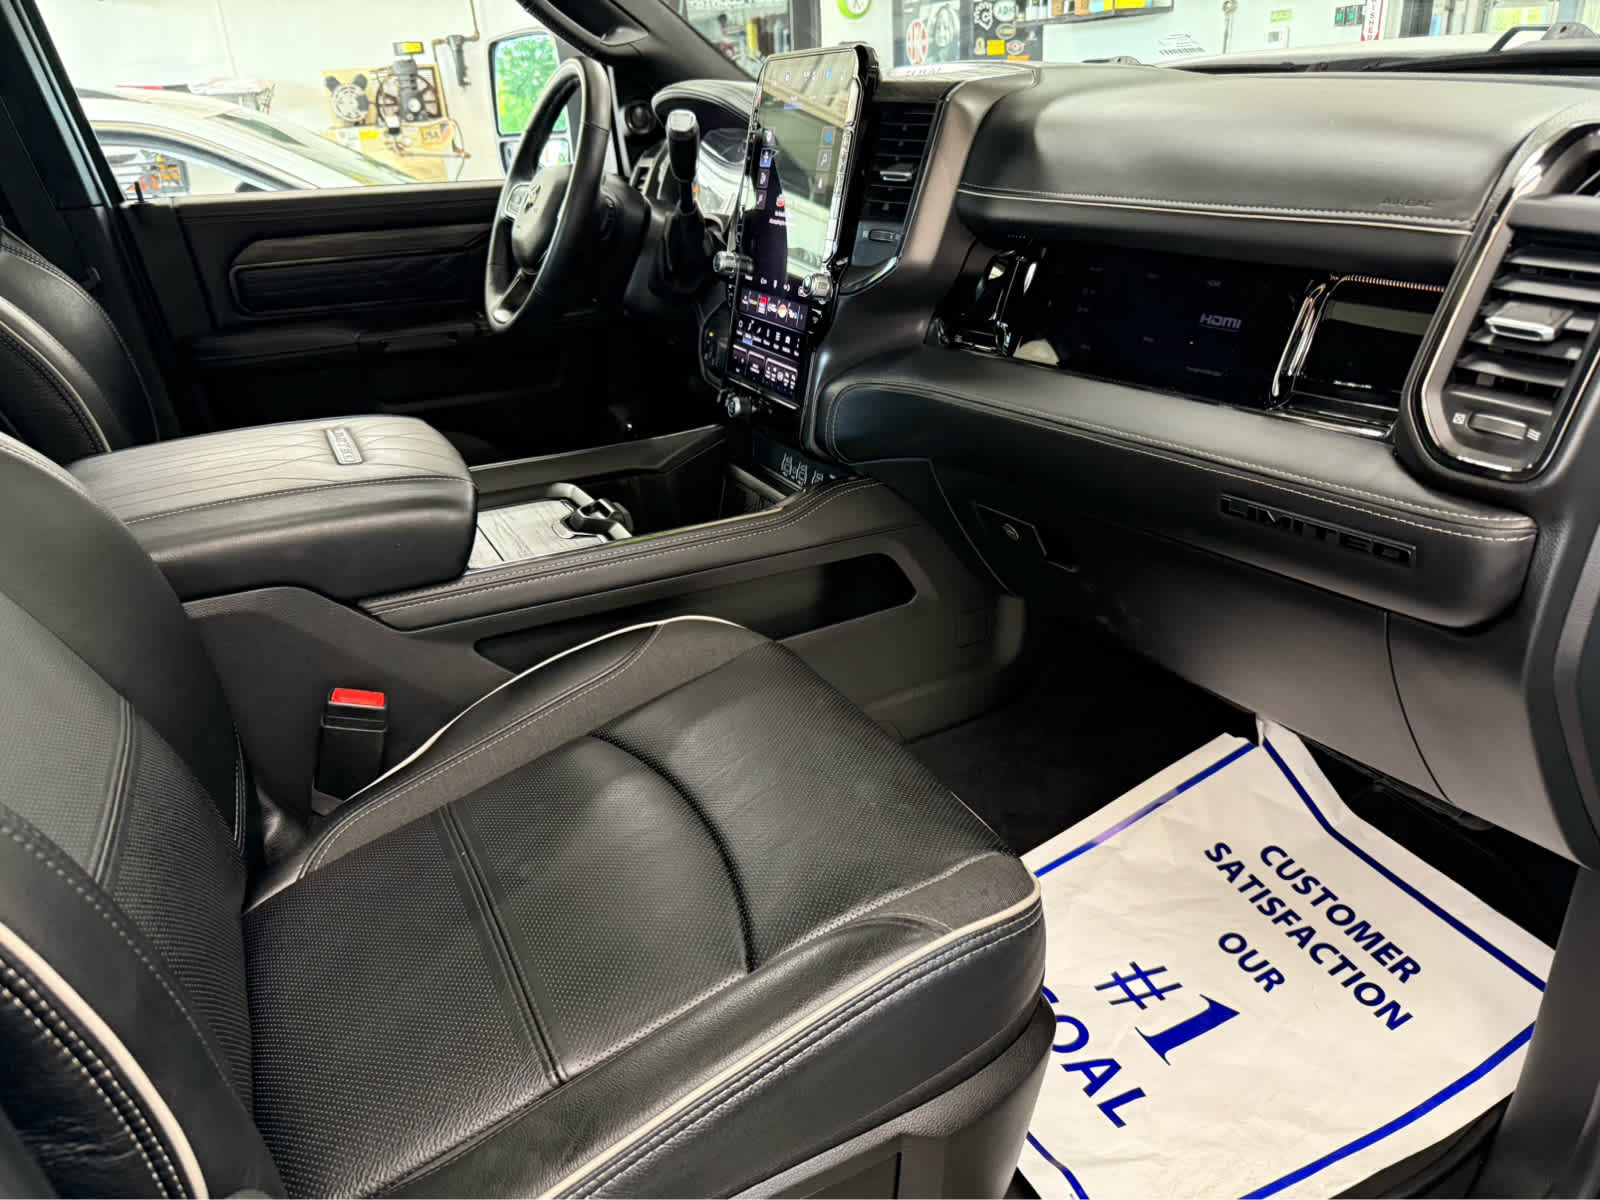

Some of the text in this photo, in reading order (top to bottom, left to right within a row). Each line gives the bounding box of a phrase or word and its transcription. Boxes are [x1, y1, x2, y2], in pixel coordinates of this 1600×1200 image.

[1200, 313, 1242, 330] HDMI
[1219, 496, 1413, 564] LIMITED
[1204, 841, 1414, 1031] SATISFACTION
[1217, 931, 1287, 994] OUR
[1260, 844, 1422, 984] CUSTOMER
[1042, 984, 1147, 1128] OAL
[1094, 961, 1241, 1066] #1
